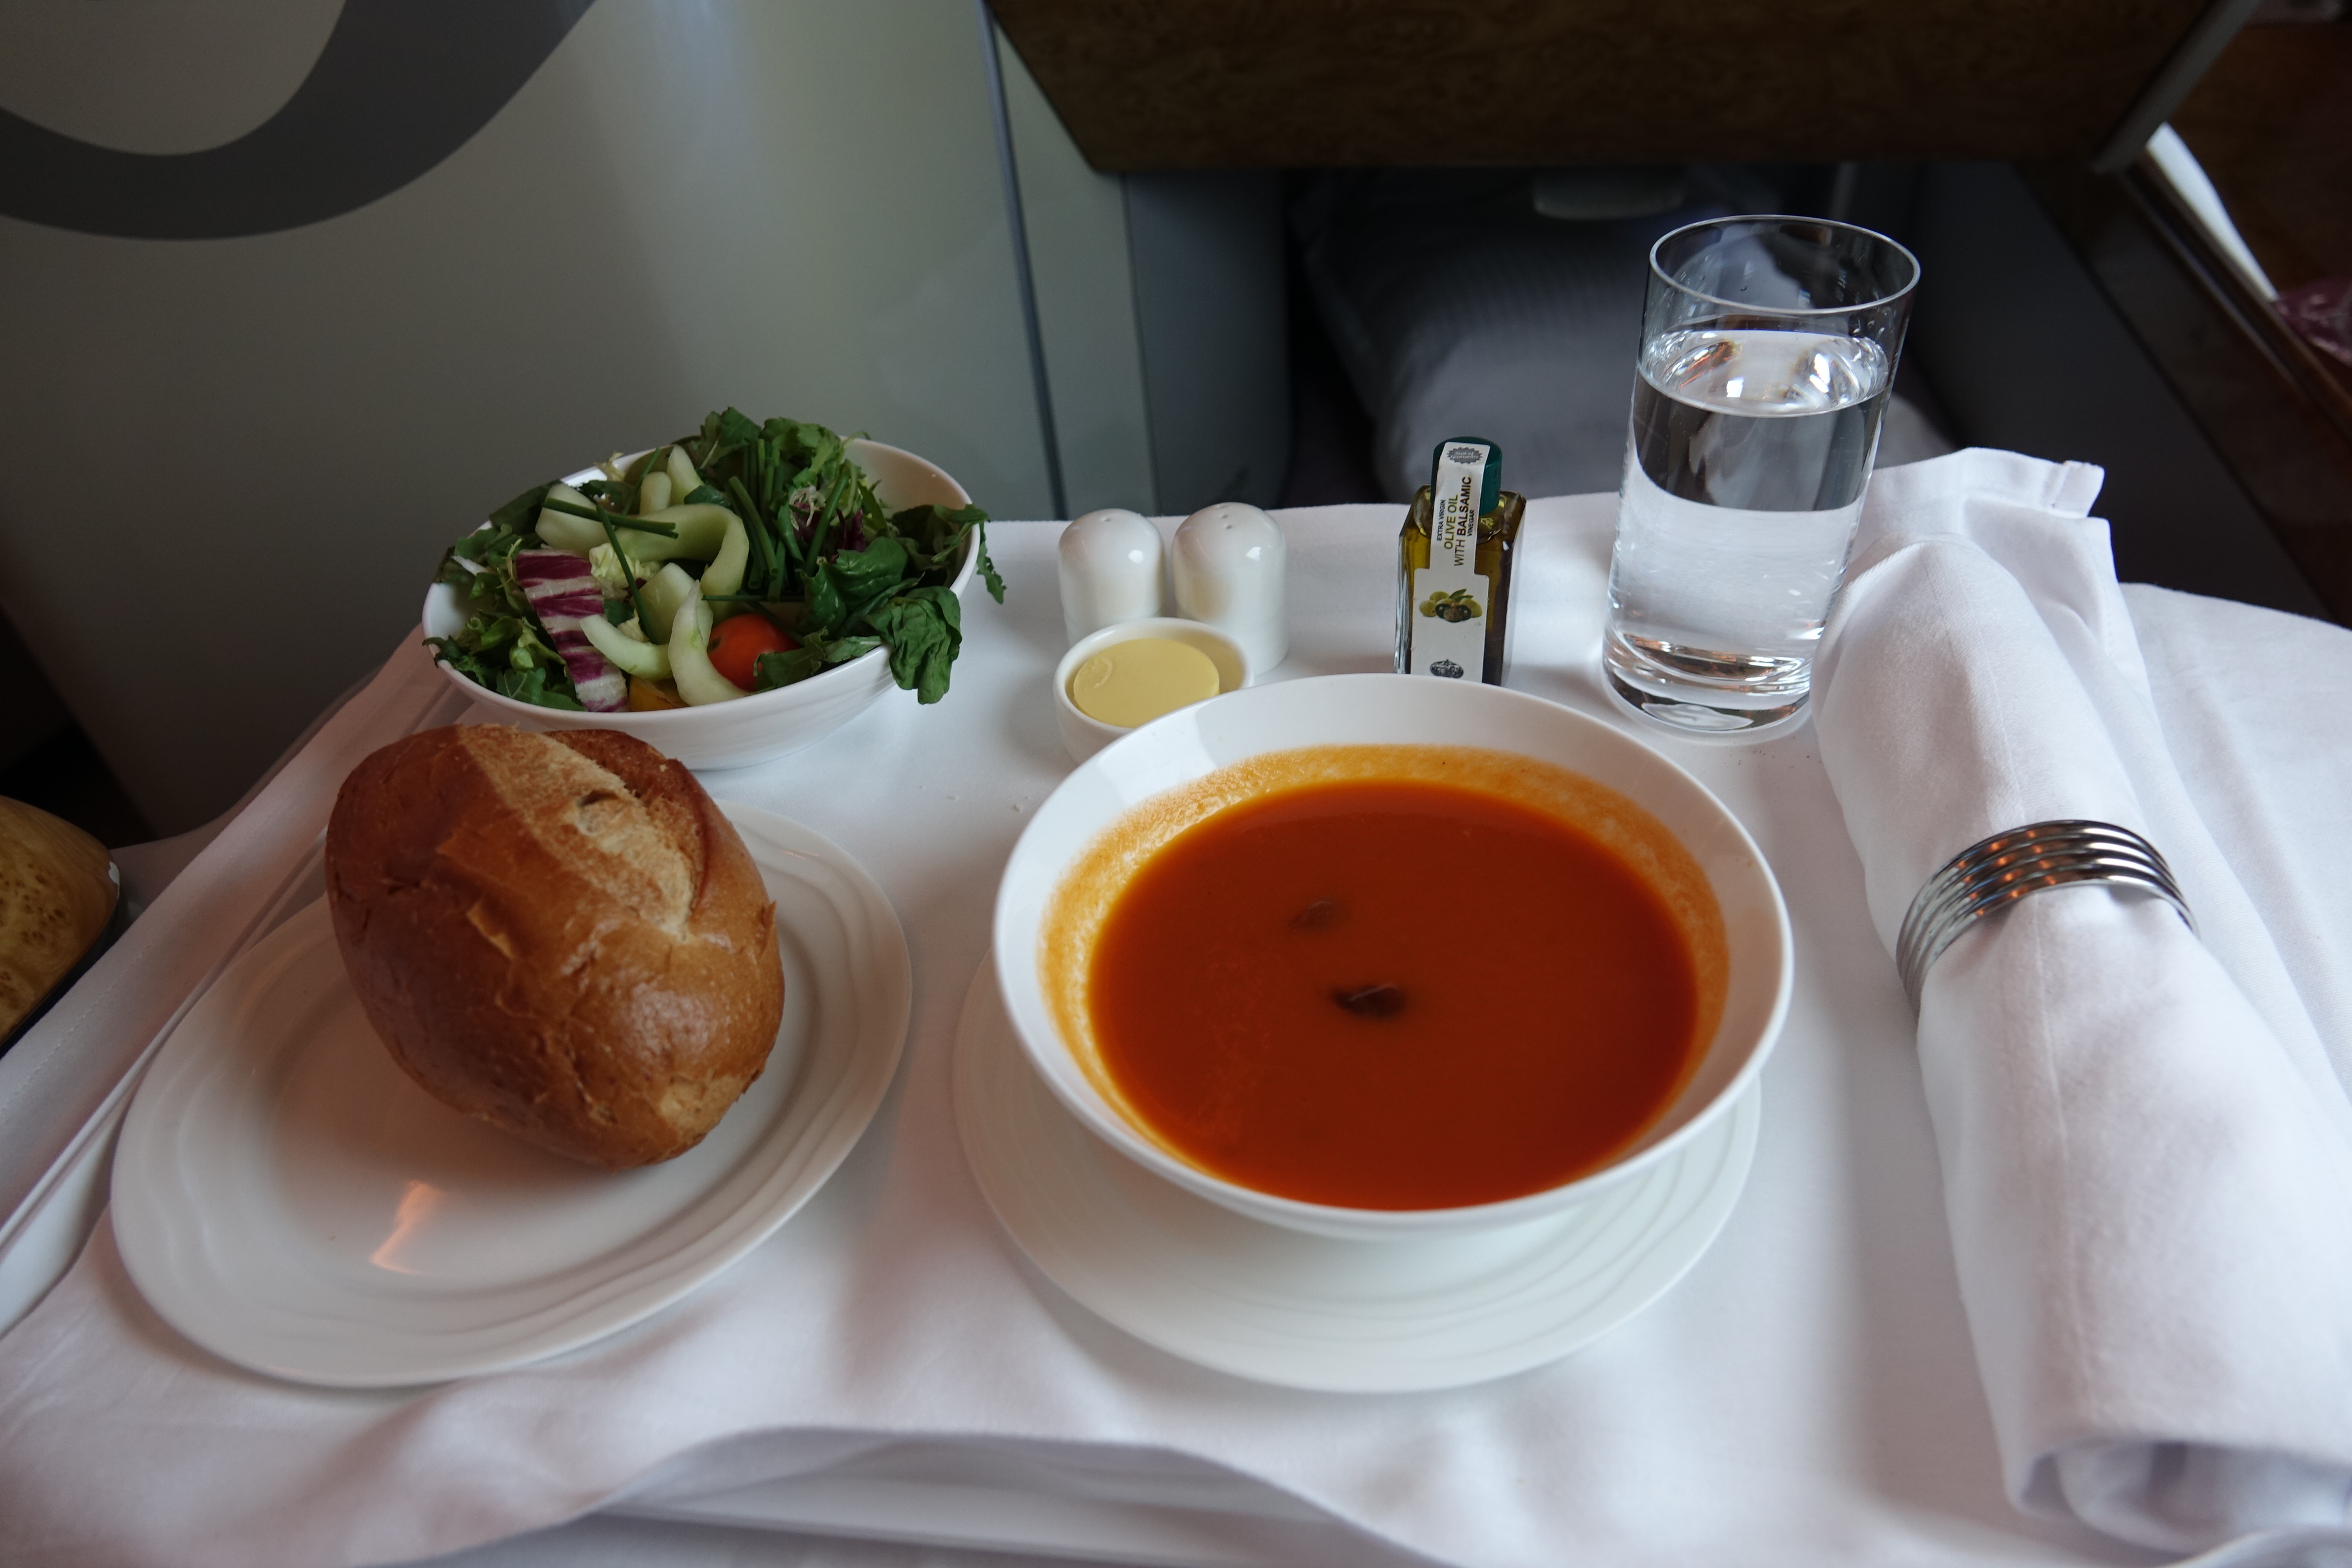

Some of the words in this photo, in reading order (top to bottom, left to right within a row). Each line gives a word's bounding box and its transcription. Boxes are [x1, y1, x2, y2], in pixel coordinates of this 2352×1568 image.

[1447, 494, 1459, 513] OIL
[1457, 476, 1472, 536] BALSAMIC
[1443, 516, 1456, 549] OLIVE
[1454, 539, 1466, 566] WITH
